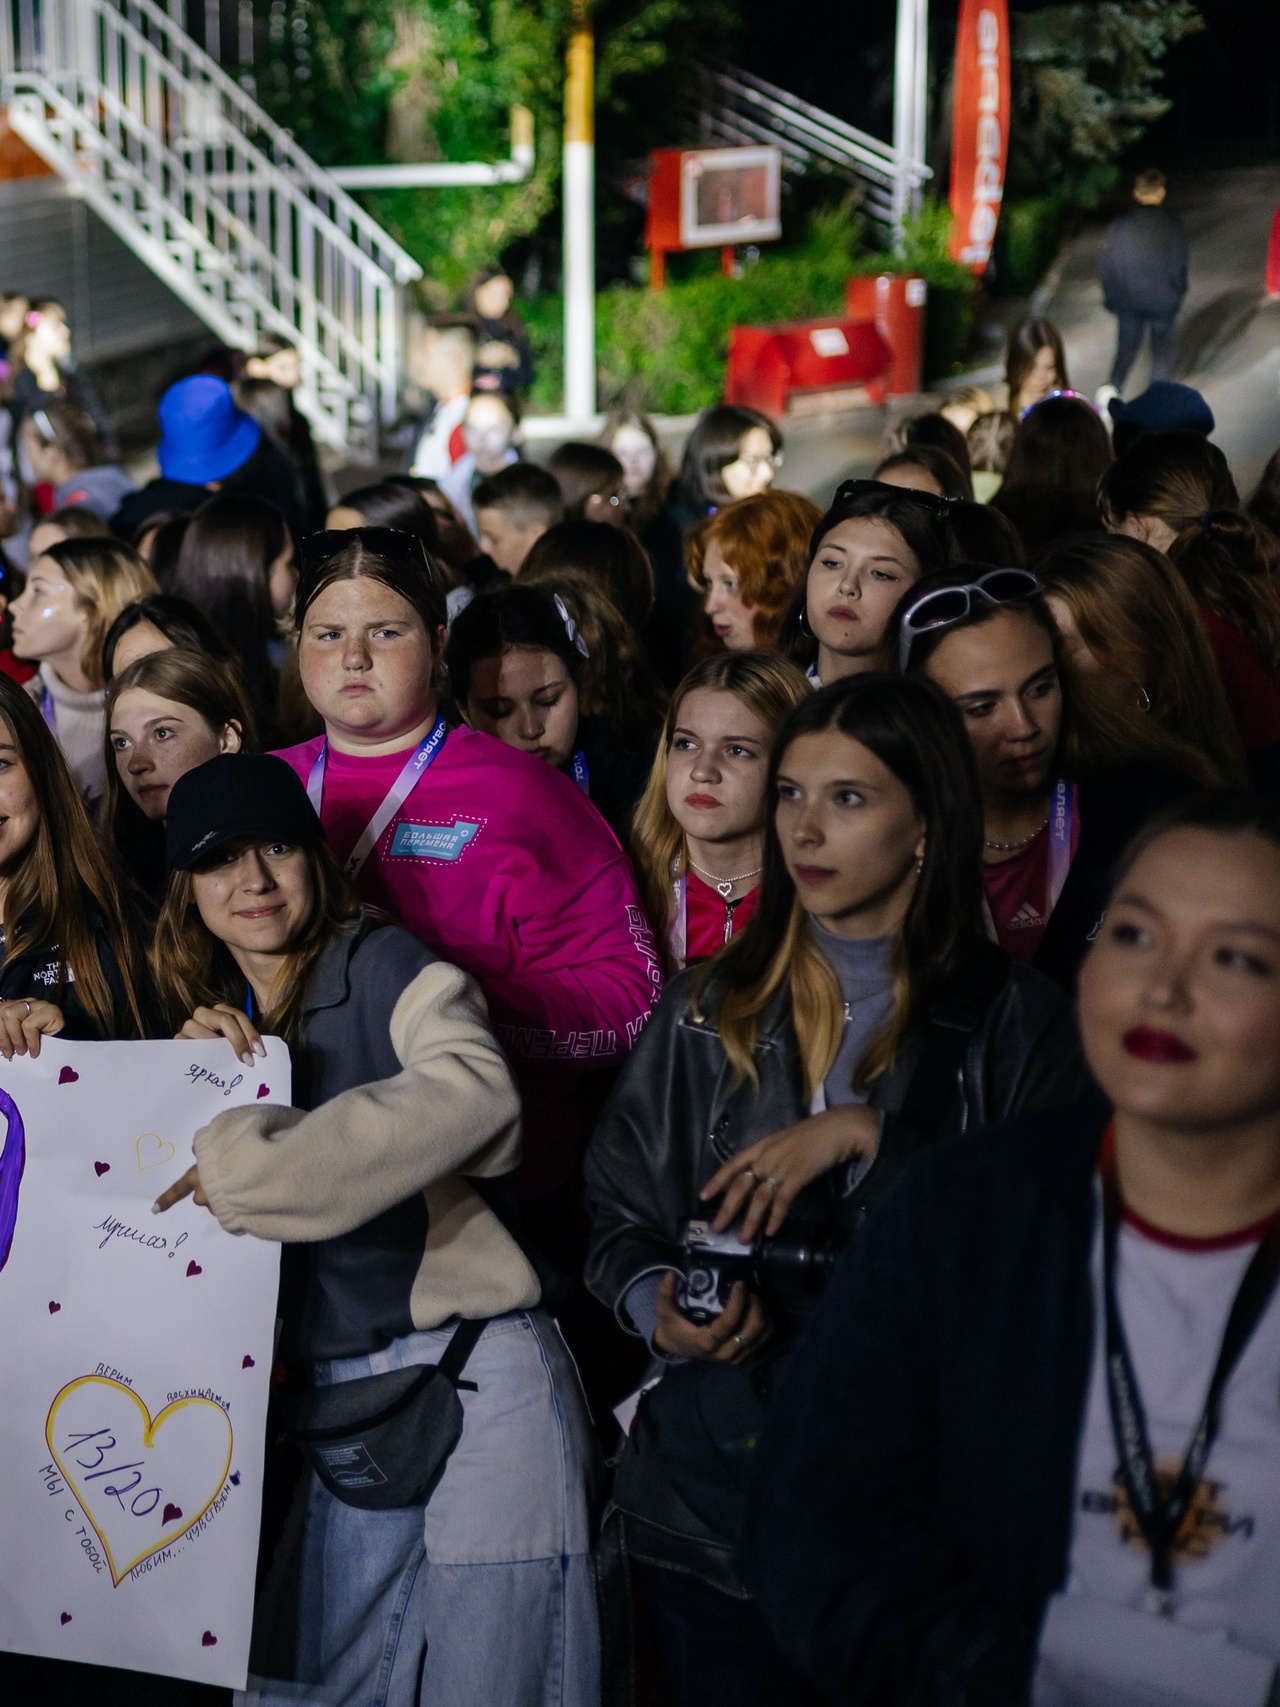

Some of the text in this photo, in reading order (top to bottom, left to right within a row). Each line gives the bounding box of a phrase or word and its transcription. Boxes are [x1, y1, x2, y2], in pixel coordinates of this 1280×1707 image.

[400, 838, 455, 850] ПЕРЕМЕНА
[403, 831, 459, 843] БОЛЬШАЯ
[46, 961, 61, 971] TH
[94, 1362, 133, 1386] ВЕРИМ
[39, 1463, 65, 1497] МЫ
[63, 1428, 163, 1517] 13/20
